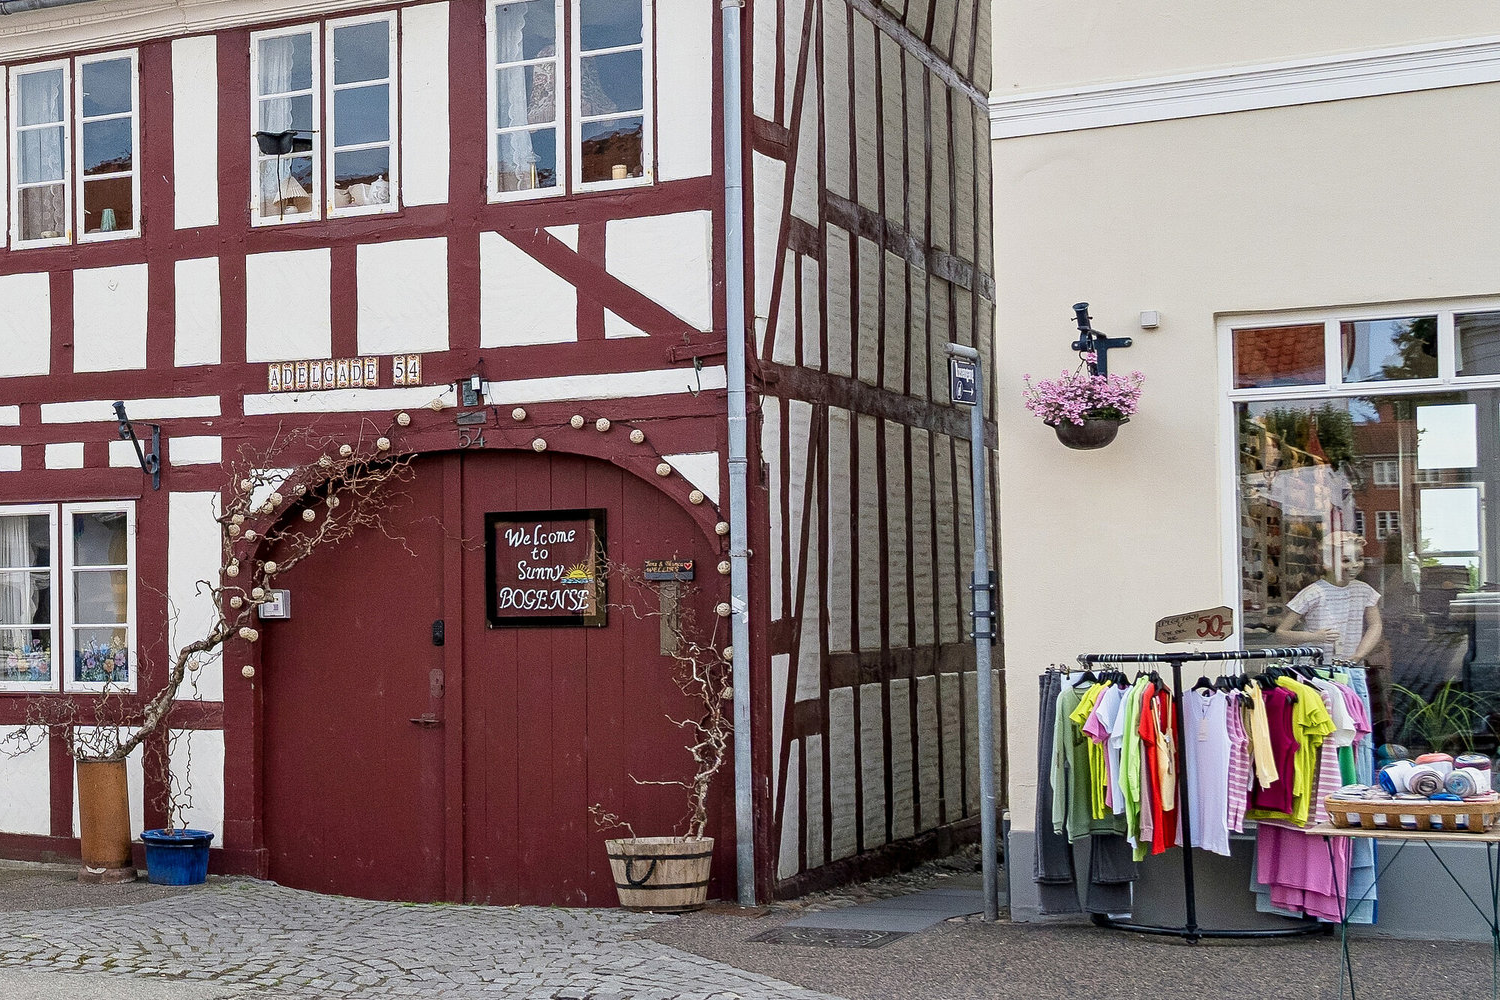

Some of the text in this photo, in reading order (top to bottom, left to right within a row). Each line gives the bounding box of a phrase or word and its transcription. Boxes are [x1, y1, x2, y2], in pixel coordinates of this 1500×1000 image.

[270, 361, 418, 386] ADELGADE 54
[459, 427, 487, 448] 54
[504, 525, 576, 547] Welcome
[531, 548, 548, 560] to
[518, 560, 565, 582] Sunny
[499, 587, 590, 611] BOGENSE
